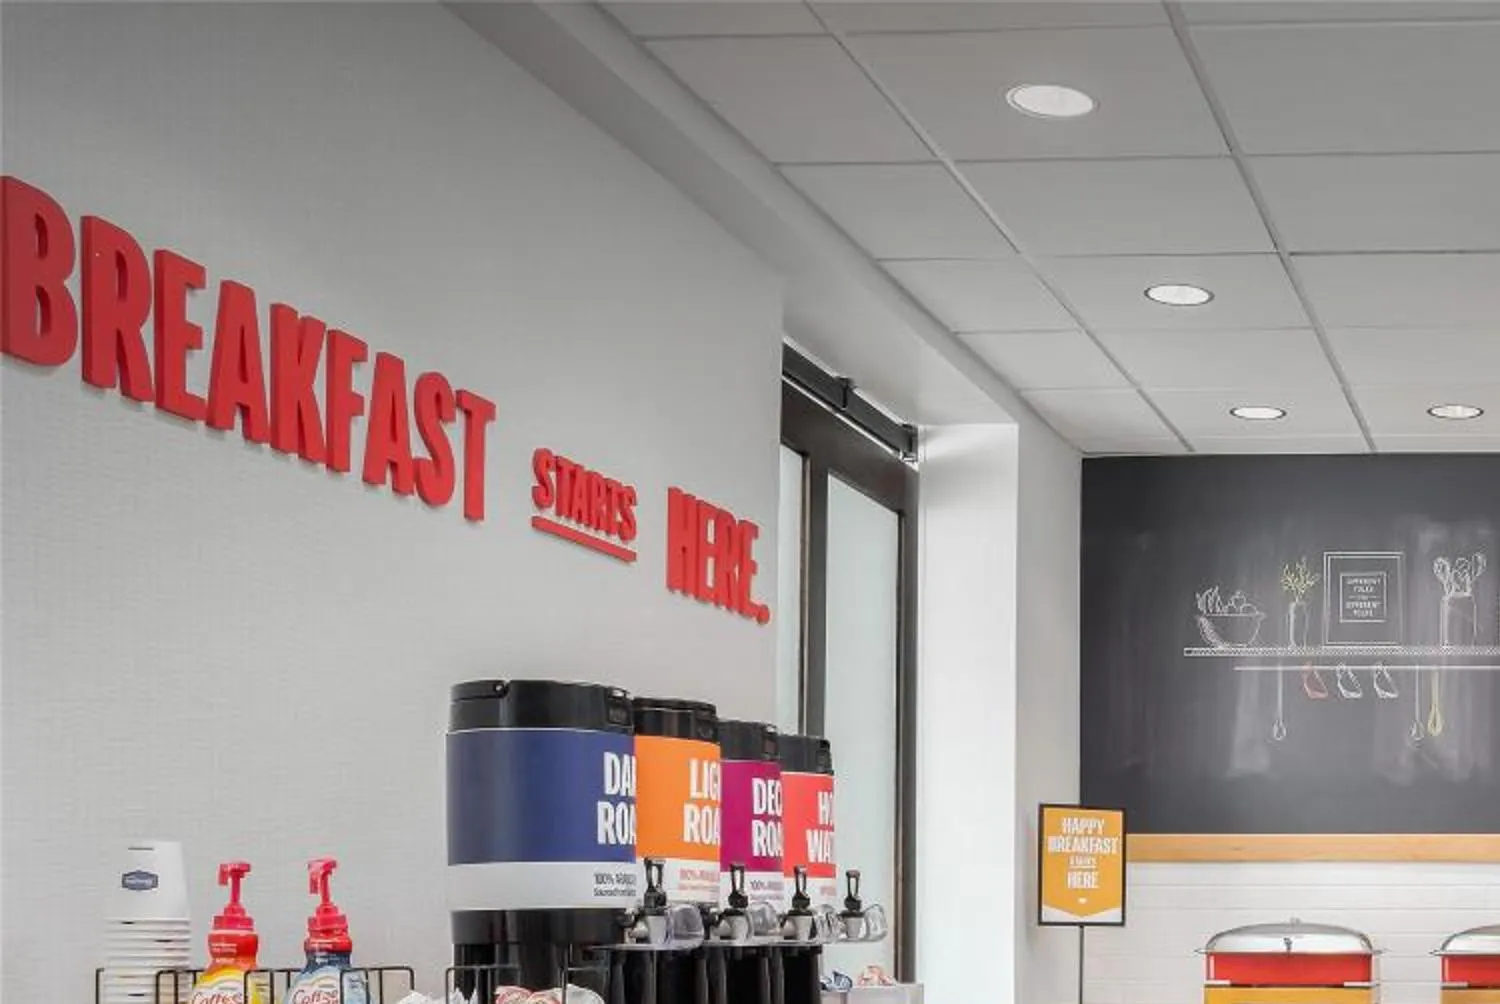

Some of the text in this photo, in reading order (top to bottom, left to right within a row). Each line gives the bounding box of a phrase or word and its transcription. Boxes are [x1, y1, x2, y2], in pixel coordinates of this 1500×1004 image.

[0, 176, 770, 624] BREAKFAST STARTS HERE.
[1062, 817, 1105, 836] HAPPY
[1047, 835, 1120, 854] BREAKFAST
[1066, 871, 1100, 889] HERE
